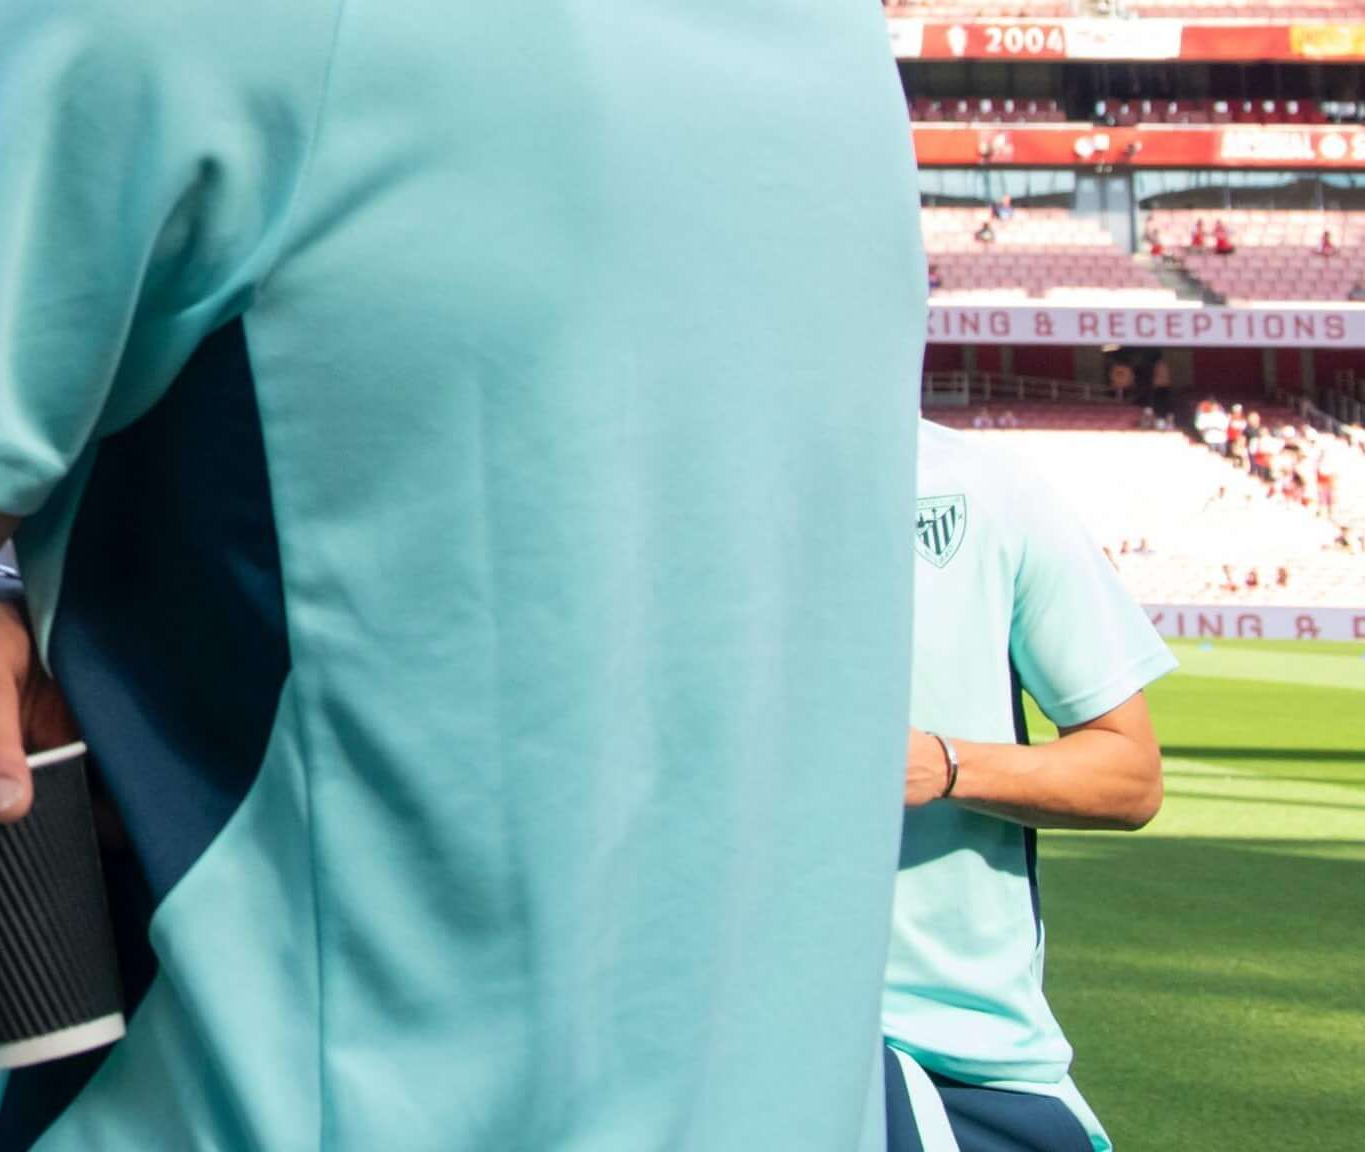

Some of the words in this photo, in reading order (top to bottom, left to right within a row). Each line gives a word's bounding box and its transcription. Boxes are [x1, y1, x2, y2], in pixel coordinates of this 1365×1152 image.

[985, 26, 1065, 53] 2004
[1034, 310, 1054, 336] &
[1079, 310, 1346, 339] RECEPTIONS
[1152, 612, 1263, 639] ING
